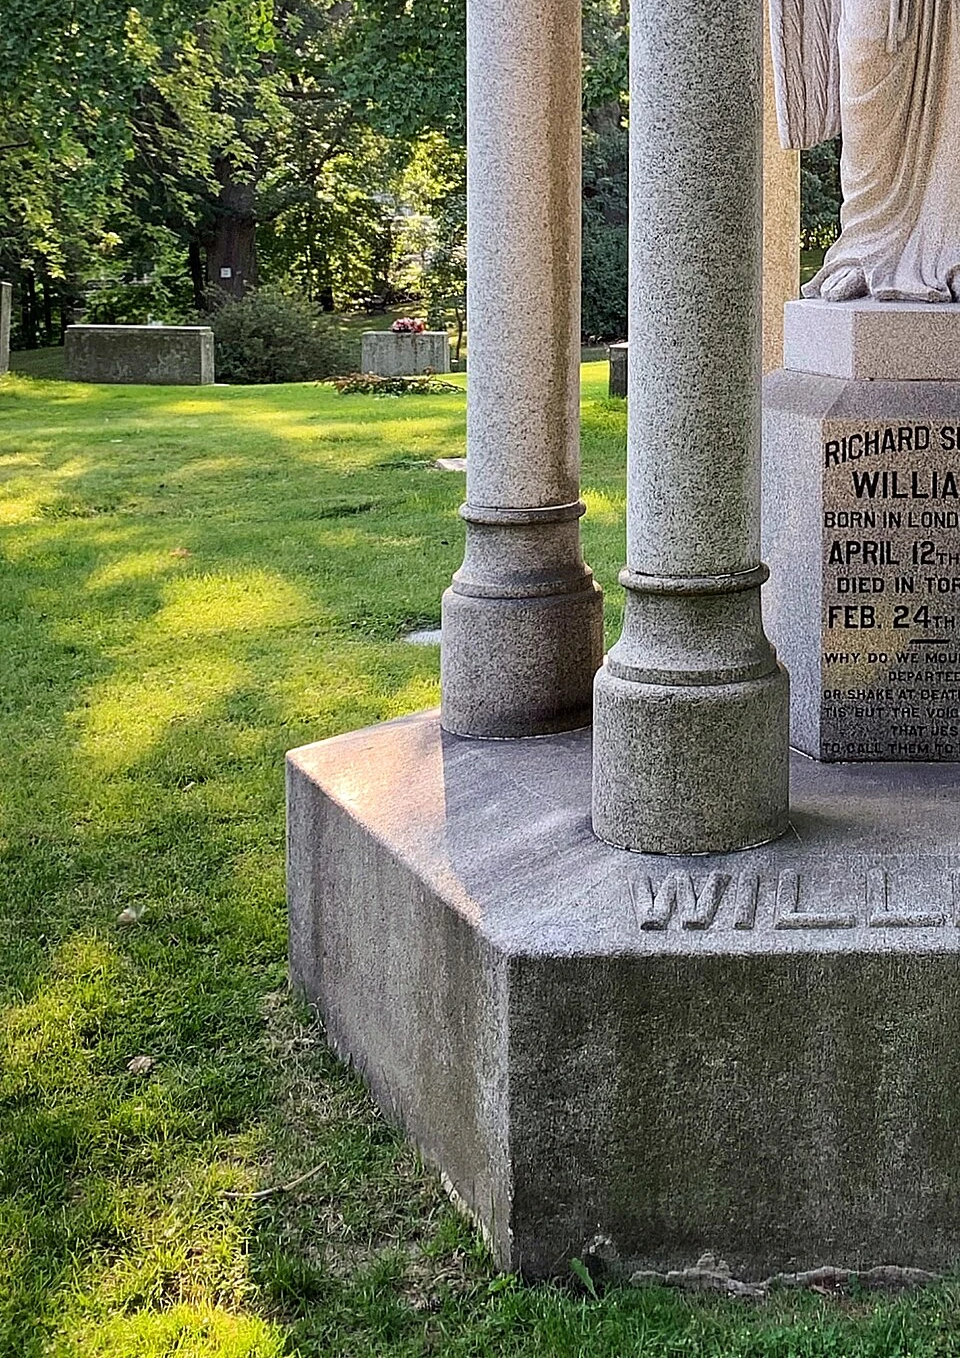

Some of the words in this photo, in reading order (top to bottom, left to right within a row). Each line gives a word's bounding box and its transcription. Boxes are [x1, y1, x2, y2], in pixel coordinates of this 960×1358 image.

[825, 426, 930, 467] RICHARD
[825, 511, 876, 529] BORN
[883, 511, 901, 529] IN
[829, 541, 900, 565] APRIL
[836, 577, 885, 593] DIED
[895, 577, 914, 593] IN
[828, 605, 882, 629] FEB.
[824, 652, 861, 665] WHY
[867, 652, 888, 664] DO
[896, 652, 919, 664] WE
[823, 689, 841, 700] OR
[847, 688, 894, 701] SHAKE
[898, 689, 916, 701] AT
[854, 707, 884, 718] BUT
[892, 707, 920, 718] THE
[891, 725, 927, 737] THAT
[823, 742, 840, 754] TO
[847, 743, 883, 754] CALL
[888, 743, 929, 754] THEM
[934, 743, 954, 754] TO
